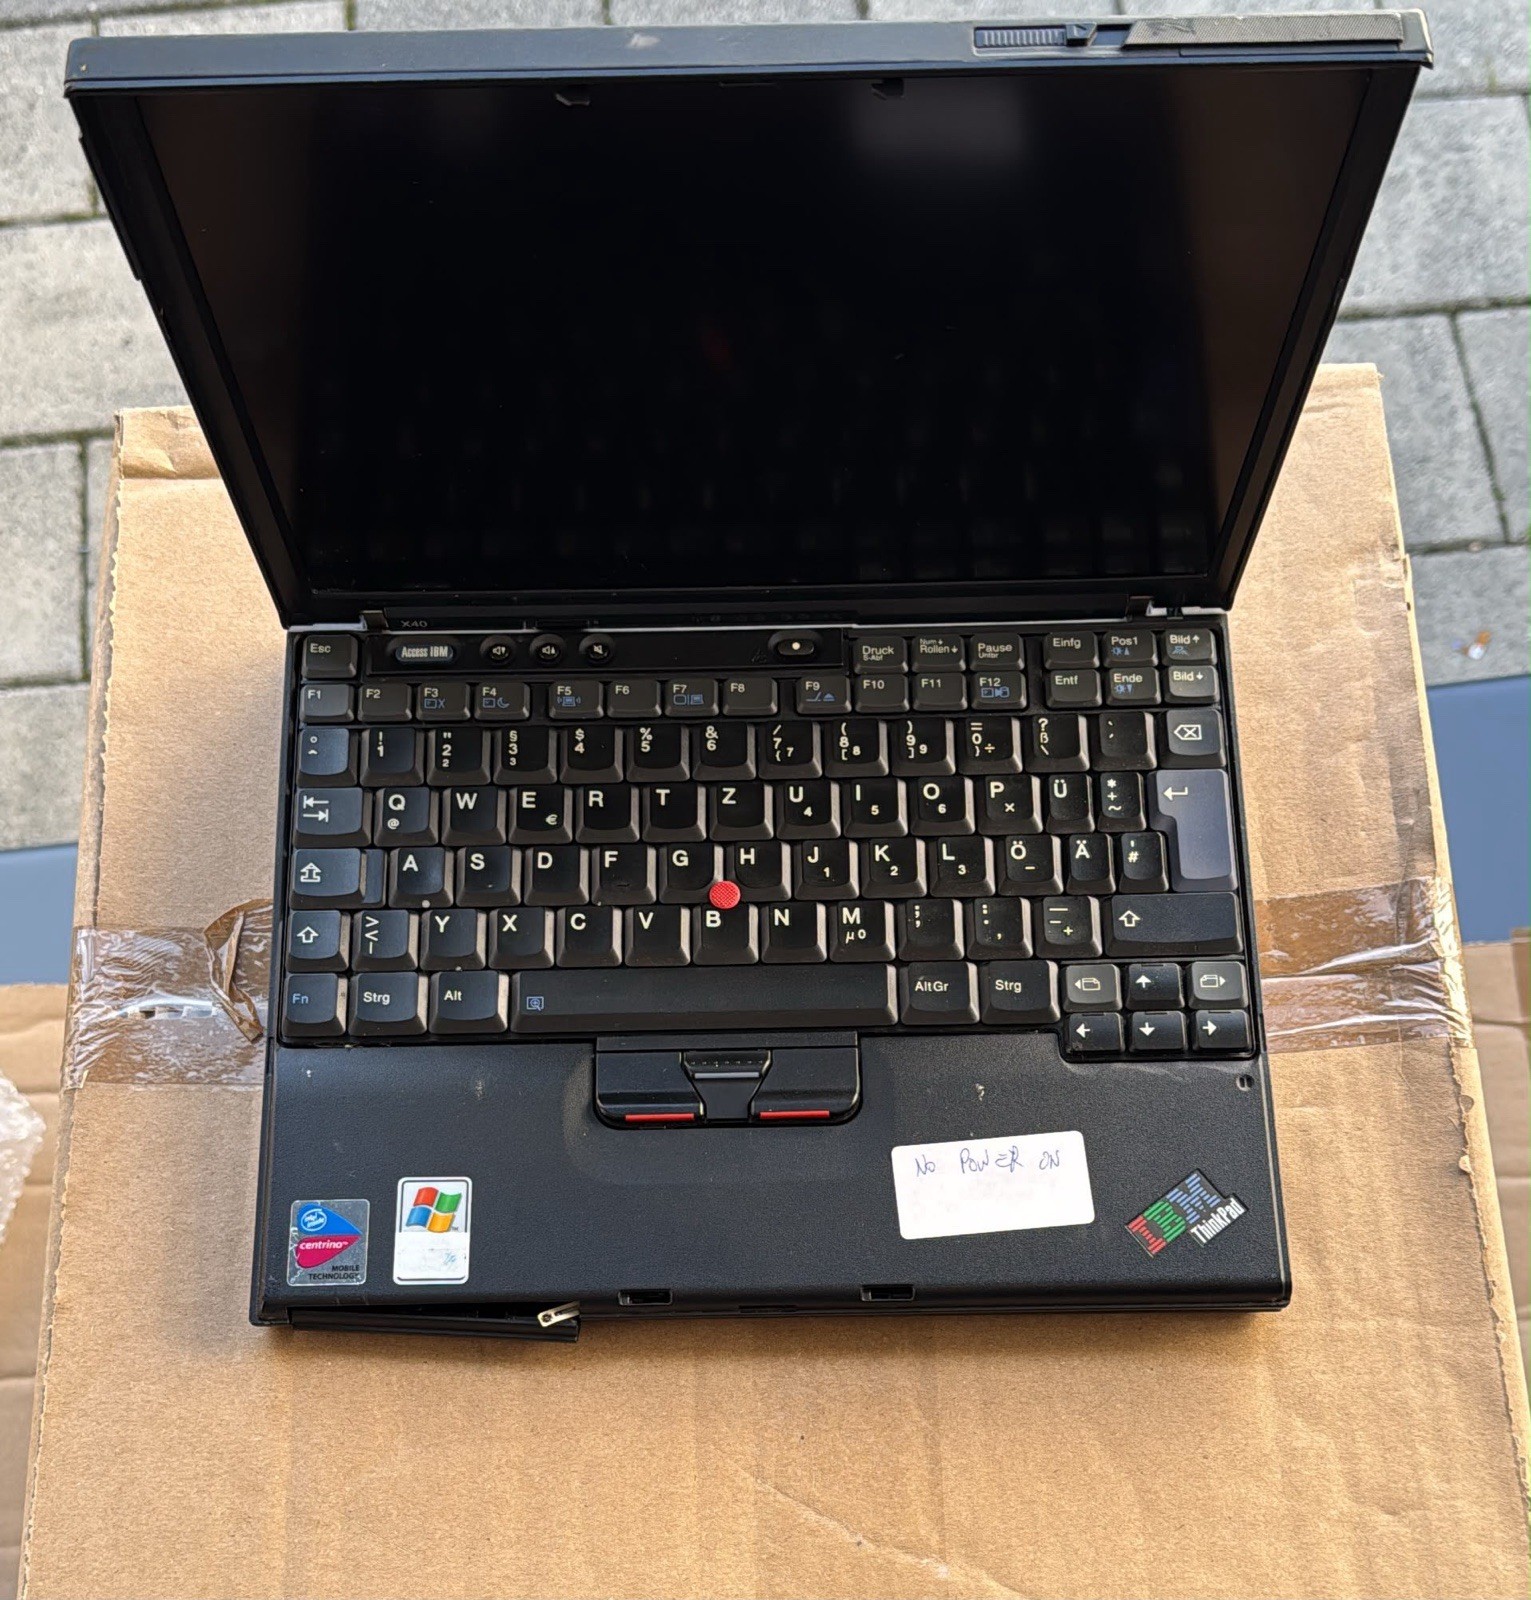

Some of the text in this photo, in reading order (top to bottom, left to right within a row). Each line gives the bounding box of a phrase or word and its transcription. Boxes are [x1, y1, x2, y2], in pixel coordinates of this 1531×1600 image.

[1053, 638, 1081, 649] Einfg
[1111, 637, 1138, 646] Pos1
[1170, 635, 1190, 644] Bild
[310, 643, 331, 653] Esc
[401, 646, 448, 657] Access IBM
[862, 646, 894, 655] Druck
[920, 645, 950, 653] Rollen
[978, 643, 1012, 652] Pause
[980, 678, 1001, 686] F12
[1055, 675, 1078, 685] Entf
[1114, 673, 1143, 683] Ende
[1173, 672, 1194, 681] Bild
[731, 683, 745, 693] F8
[806, 681, 820, 691] F9
[863, 680, 885, 689] F10
[921, 678, 941, 687] F11
[308, 689, 321, 699] F1
[366, 689, 381, 699] F2
[424, 688, 439, 697] F3
[483, 687, 497, 696] F4
[557, 686, 572, 695] F5
[615, 685, 630, 695] F6
[673, 685, 687, 694] F7
[773, 725, 781, 736] /
[841, 722, 846, 734] (
[907, 721, 912, 733] )
[971, 722, 983, 730] =
[1038, 719, 1048, 731] ?
[509, 730, 517, 741] §
[575, 728, 585, 740] $
[640, 728, 652, 740] %
[706, 726, 718, 738] &
[707, 740, 716, 750] 6
[774, 738, 782, 749] 7
[839, 736, 849, 747] 8
[906, 734, 916, 746] 9
[971, 734, 982, 745] 0
[377, 746, 384, 757] 1
[442, 745, 452, 756] 2
[508, 743, 518, 754] 3
[574, 743, 585, 753] 4
[641, 741, 650, 752] 5
[852, 746, 860, 756] 8
[919, 744, 928, 754] 9
[786, 748, 794, 757] 7
[442, 758, 449, 767] 2
[509, 757, 517, 766] 3
[789, 786, 804, 802] U
[856, 784, 860, 801] I
[923, 783, 940, 800] O
[990, 782, 1004, 798] P
[1054, 779, 1067, 798] Ü
[456, 793, 477, 809] W
[522, 791, 537, 808] E
[588, 790, 604, 807] R
[656, 789, 670, 806] T
[722, 788, 736, 804] Z
[388, 794, 405, 811] Q
[803, 806, 812, 816] 4
[871, 806, 879, 815] 5
[938, 803, 946, 814] 6
[387, 818, 400, 829] @
[546, 814, 558, 825] €
[874, 846, 890, 861] K
[942, 846, 955, 860] L
[1011, 840, 1026, 859] Ö
[1075, 840, 1090, 858] Ä
[537, 852, 553, 869] D
[604, 851, 618, 867] F
[672, 850, 688, 866] G
[740, 848, 755, 864] H
[807, 847, 818, 863] J
[1128, 851, 1138, 862] #
[402, 855, 418, 871] A
[470, 854, 485, 870] S
[824, 868, 830, 877] 1
[890, 866, 898, 876] 2
[958, 865, 966, 875] 3
[638, 912, 654, 929] V
[706, 911, 722, 927] B
[774, 909, 790, 926] N
[842, 907, 860, 924] M
[435, 916, 450, 933] Y
[502, 915, 517, 931] X
[570, 914, 586, 930] C
[995, 980, 1021, 993] Strg
[292, 994, 308, 1004] Fn
[363, 992, 390, 1006] Strg
[444, 990, 462, 1001] Alt
[1128, 1173, 1221, 1254] IBM
[1190, 1198, 1245, 1244] ThinkPad
